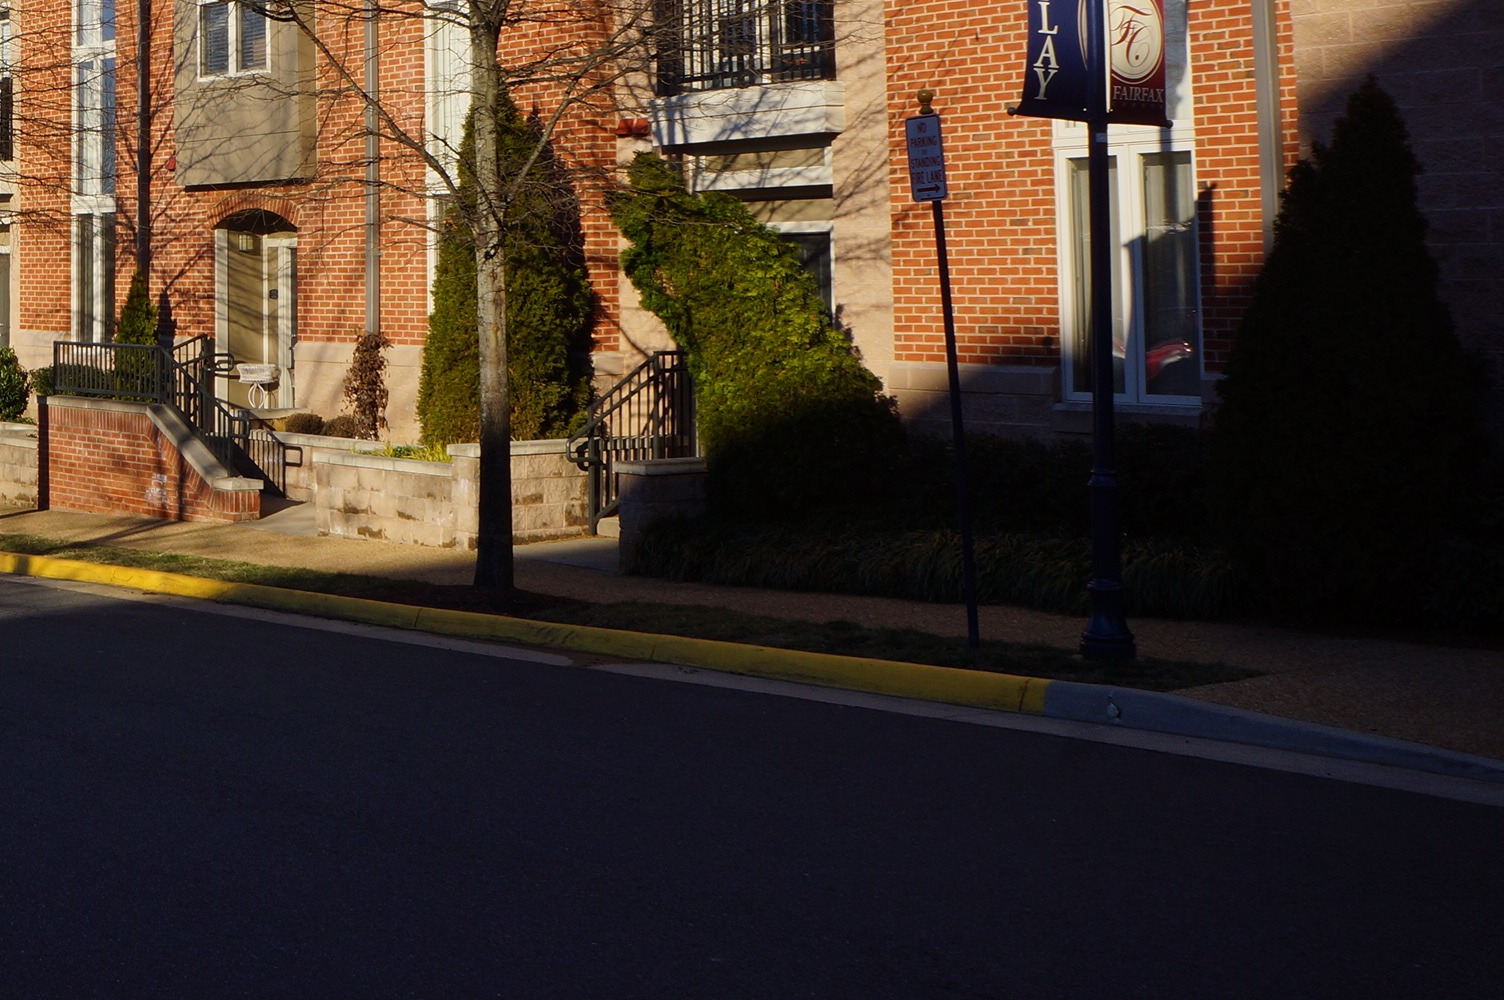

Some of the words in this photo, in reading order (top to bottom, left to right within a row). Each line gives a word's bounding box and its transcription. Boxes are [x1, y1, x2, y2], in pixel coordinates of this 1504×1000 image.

[1112, 85, 1164, 103] FAIRFAX
[917, 122, 927, 134] NO
[910, 135, 937, 148] PARKING
[911, 156, 941, 169] STANDING
[912, 171, 925, 185] FIRE
[926, 170, 943, 183] LANE
